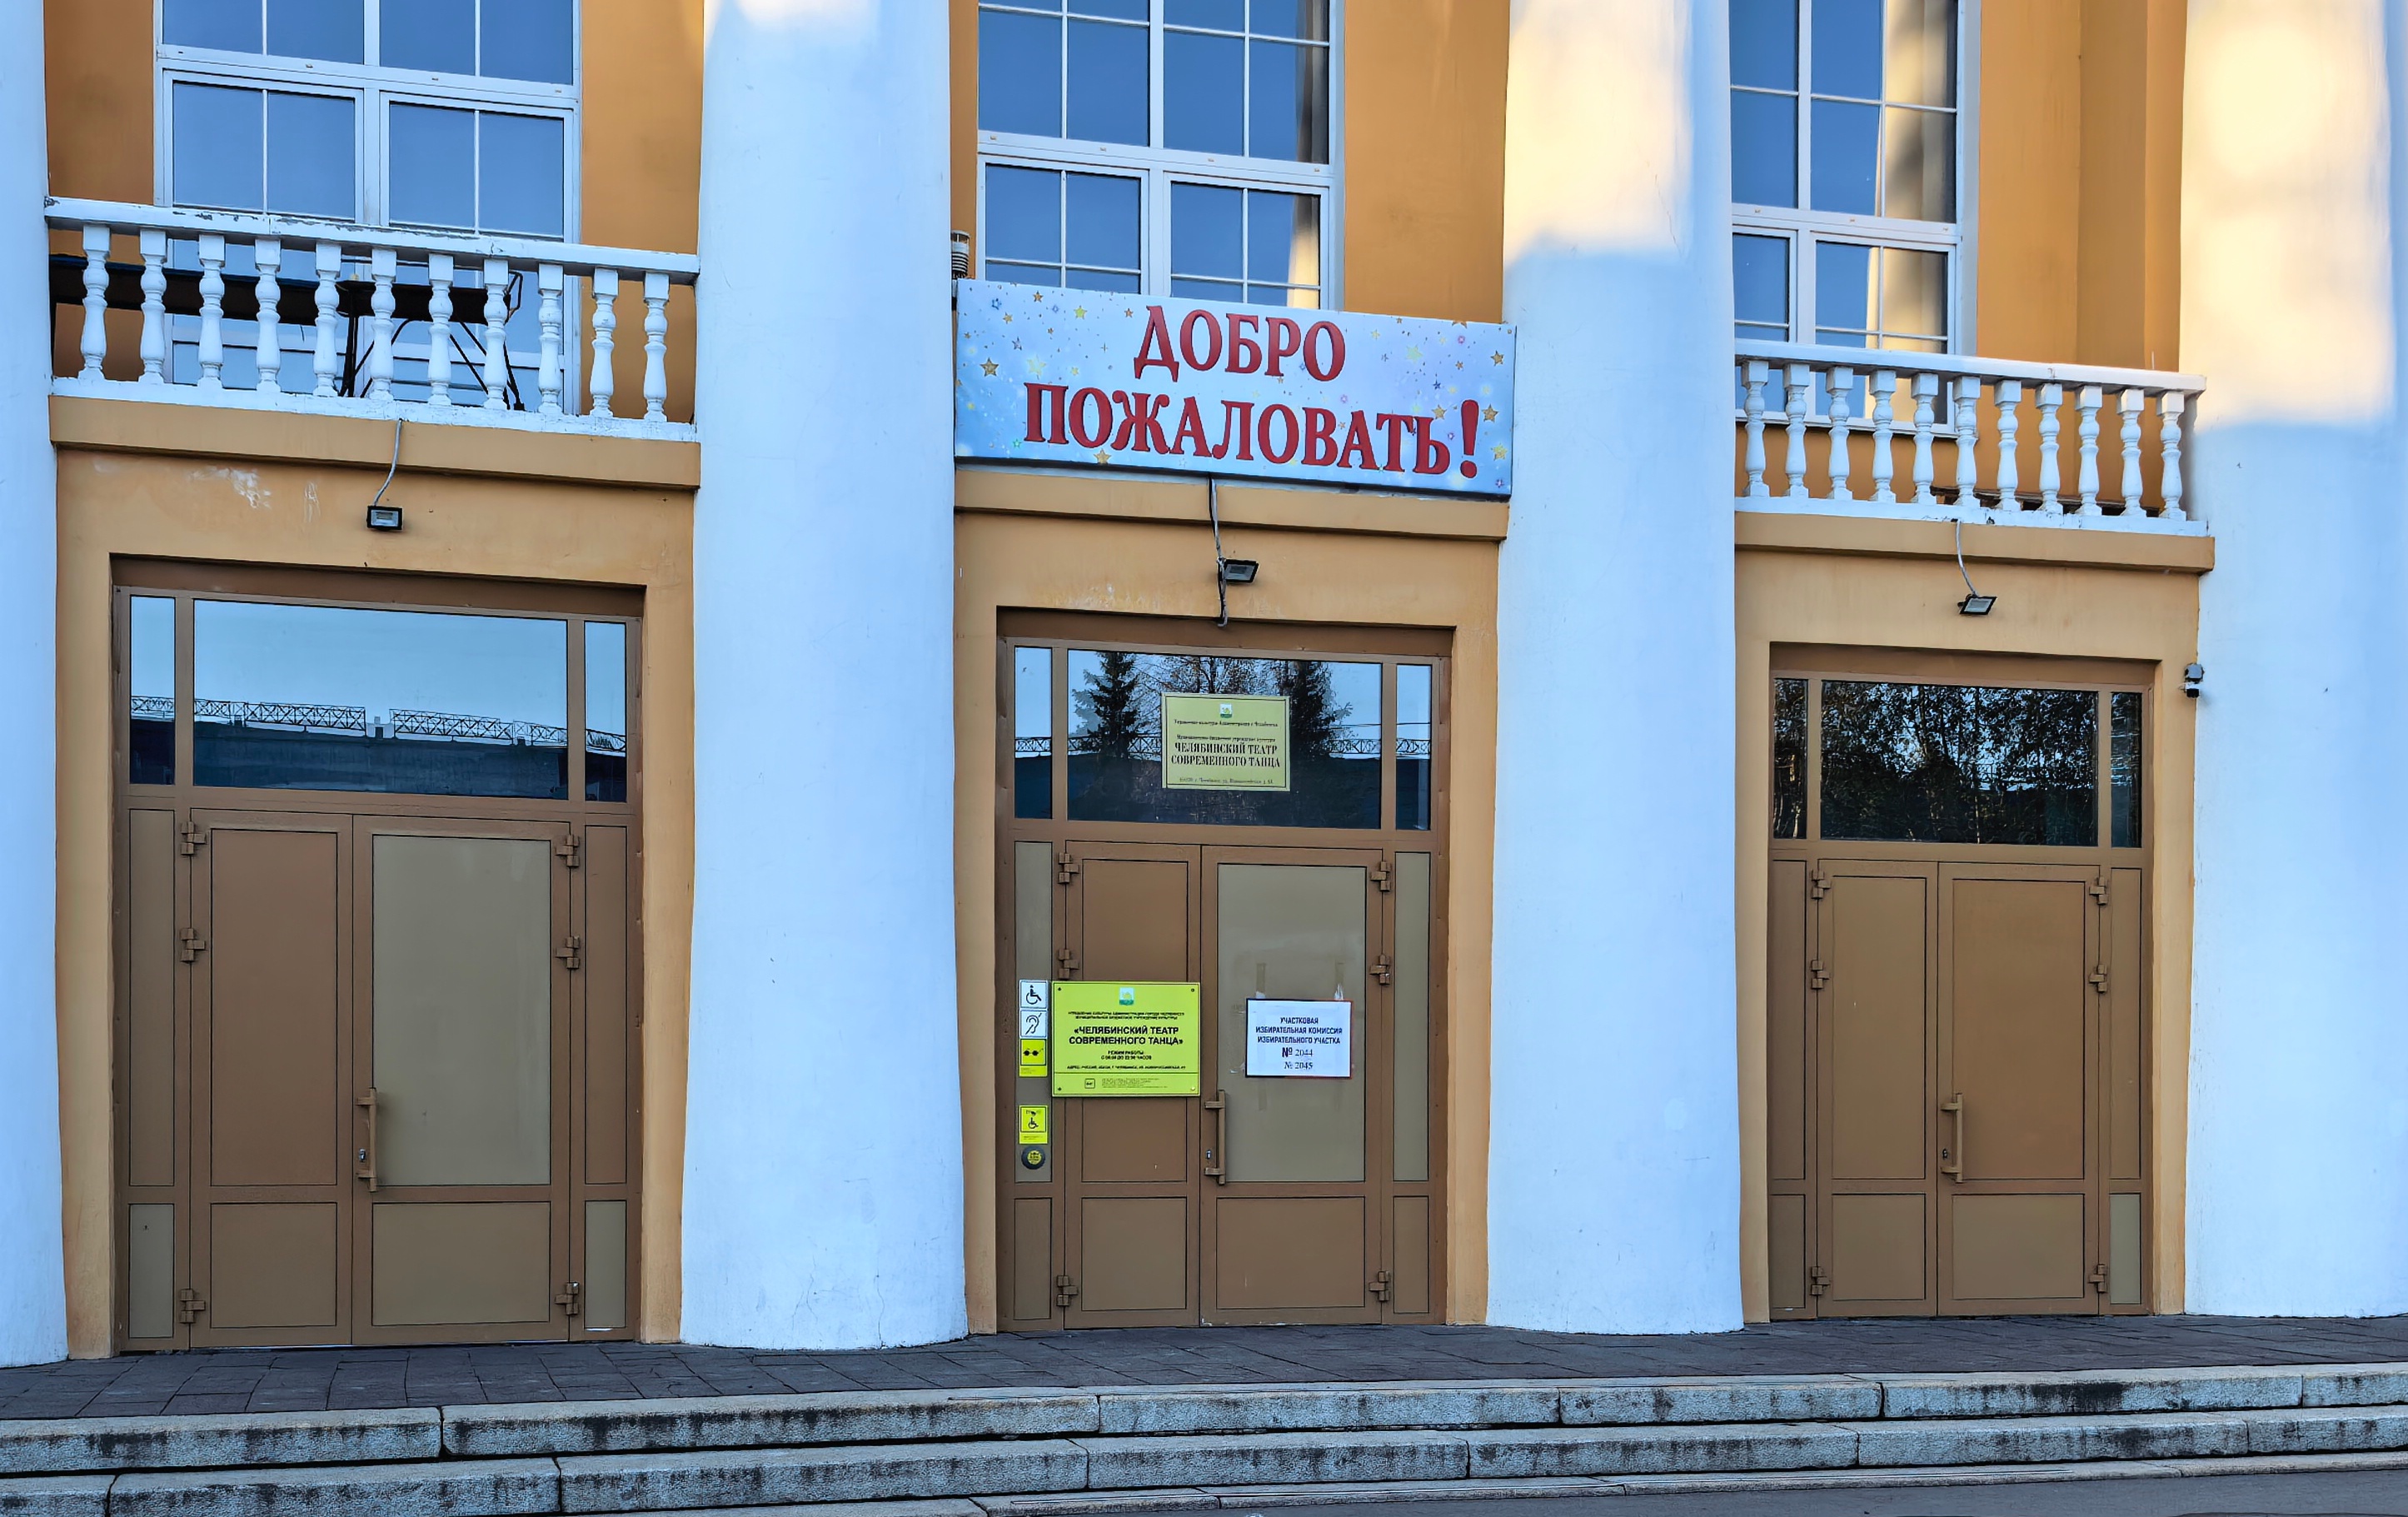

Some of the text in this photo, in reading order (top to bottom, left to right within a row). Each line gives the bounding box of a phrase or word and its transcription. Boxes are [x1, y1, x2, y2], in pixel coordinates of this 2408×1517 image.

[1134, 305, 1346, 382] ДОБРО
[1024, 382, 1480, 479] ПОЖАЛОВАТЬ!
[1174, 741, 1278, 755] ЧЕЛЯБИНСКИЙ ТЕАТР
[1171, 755, 1280, 768] СОВРЕМЕННОГО ТАНЦА
[1074, 1025, 1179, 1035] «ЧЕЛЯБИНСКИЙ ТЕАТР
[1255, 1025, 1343, 1035] ИЗБИРАТЕЛЬНАЯ КОМИССИЯ
[1069, 1036, 1184, 1045] СОВРЕМЕННОГО ТАНЦА»
[1258, 1035, 1341, 1045] ИЗБИРАТЕЛЬНОГО УЧАСТКА
